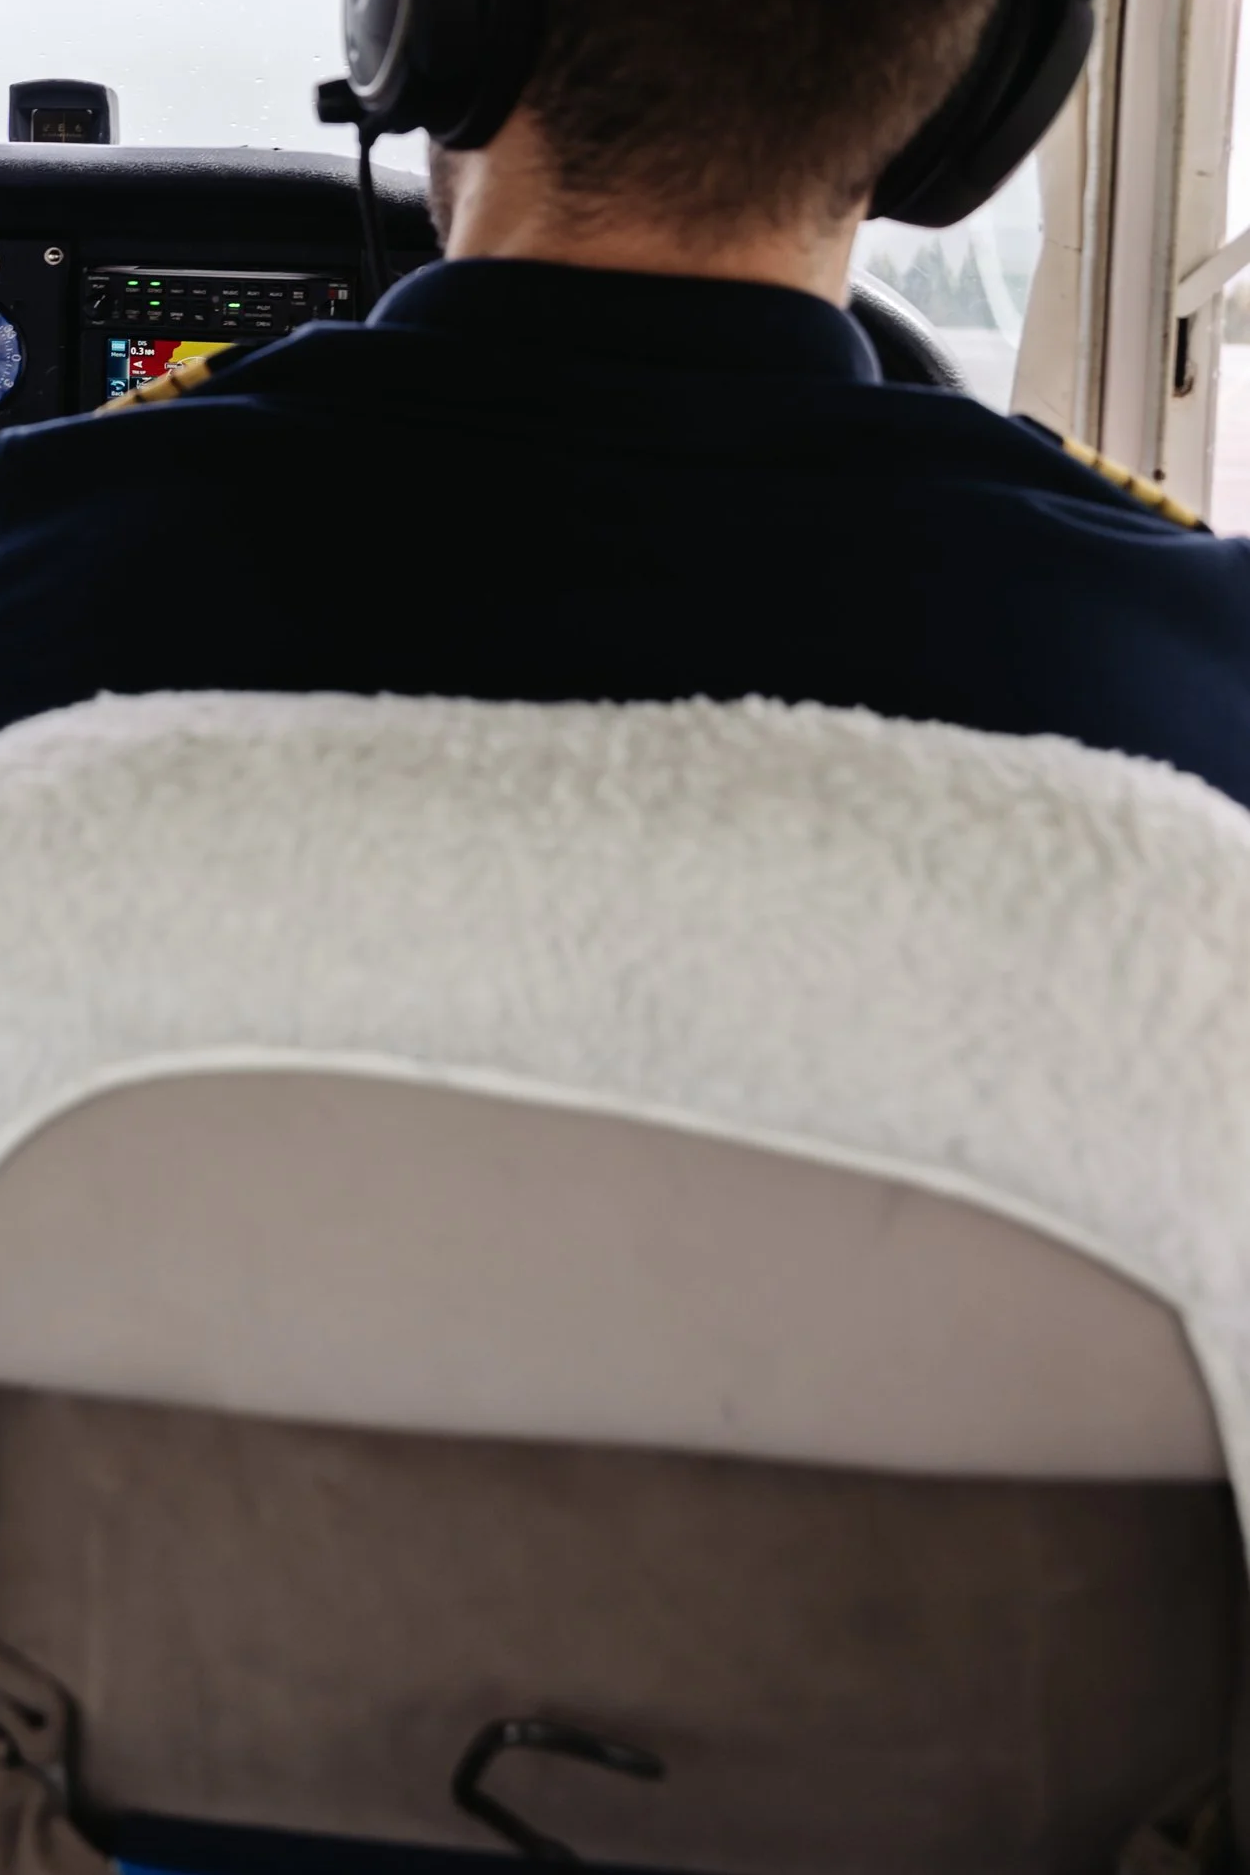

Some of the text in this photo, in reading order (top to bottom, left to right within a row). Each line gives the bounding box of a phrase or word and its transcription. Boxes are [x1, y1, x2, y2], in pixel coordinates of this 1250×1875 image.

[131, 347, 144, 355] 0.3
[12, 354, 22, 362] 0
[4, 378, 14, 388] 3
